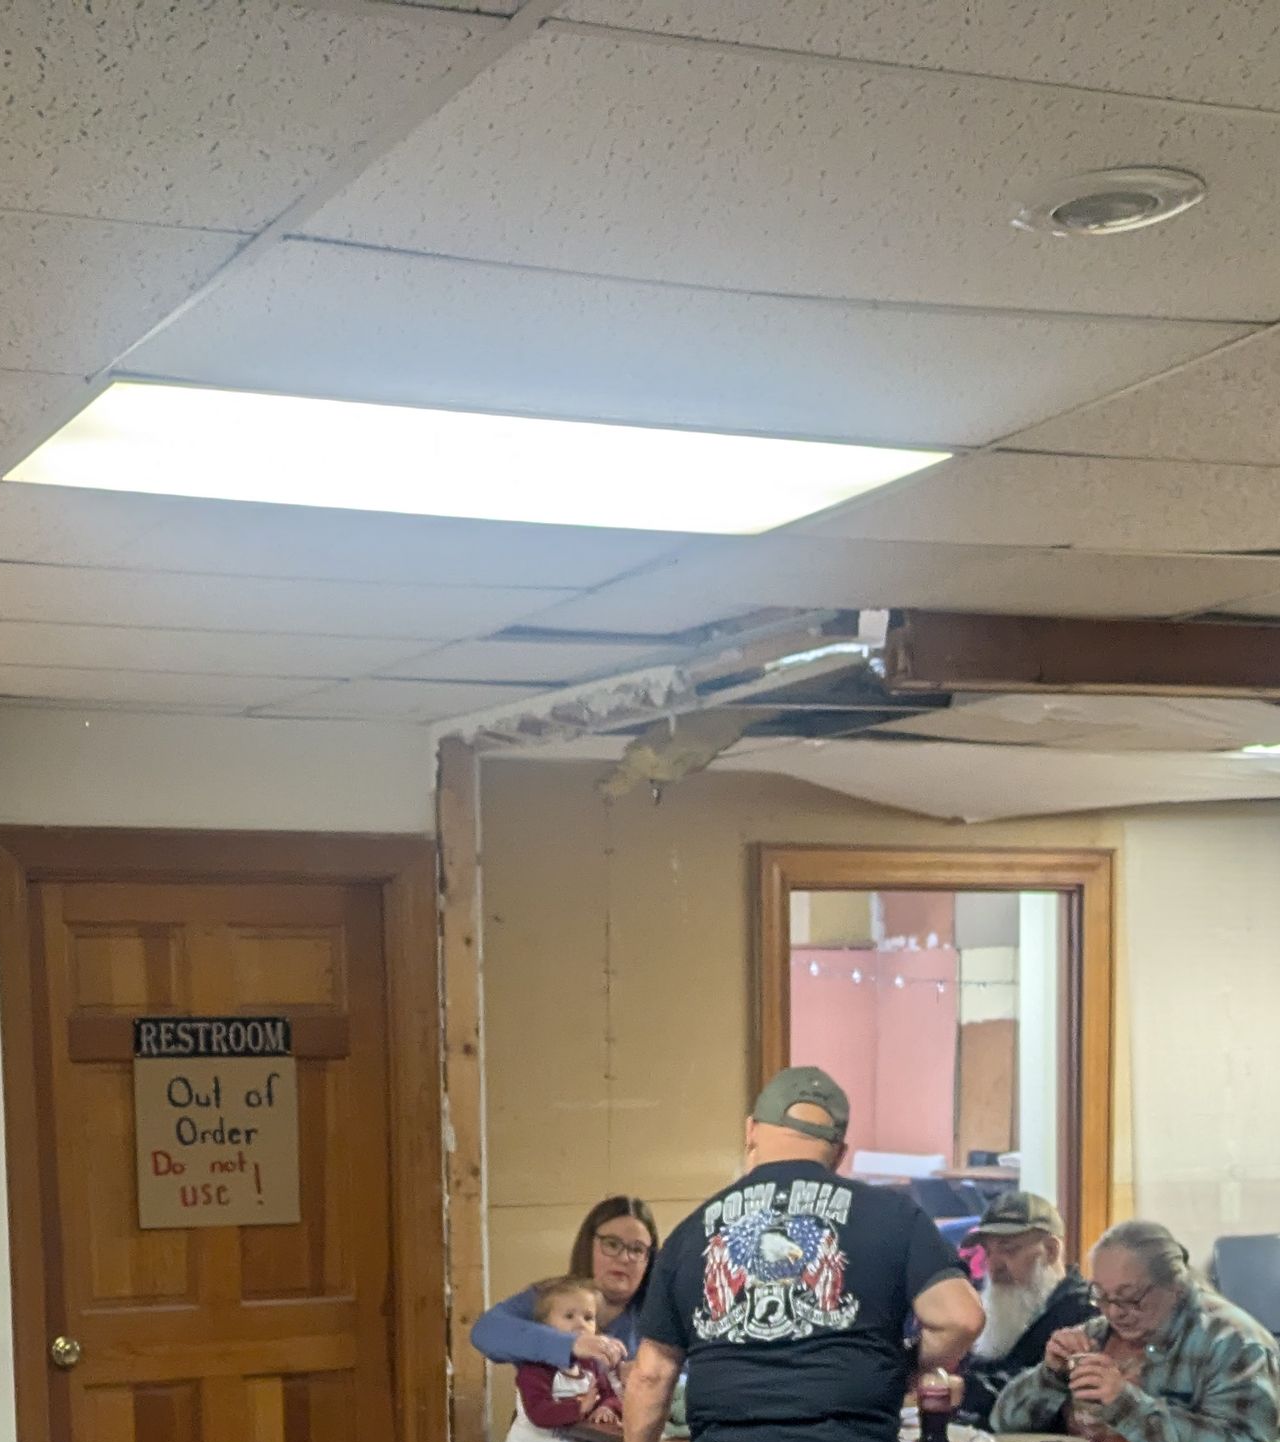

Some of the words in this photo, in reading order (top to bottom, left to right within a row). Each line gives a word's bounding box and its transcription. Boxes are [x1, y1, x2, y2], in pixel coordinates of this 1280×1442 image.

[140, 1021, 286, 1055] RESTROOM
[167, 1076, 221, 1108] Out
[245, 1073, 280, 1108] of
[176, 1116, 258, 1146] Order
[152, 1150, 186, 1176] Do
[209, 1150, 246, 1174] not
[704, 1181, 776, 1238] POW
[788, 1179, 853, 1225] MIA
